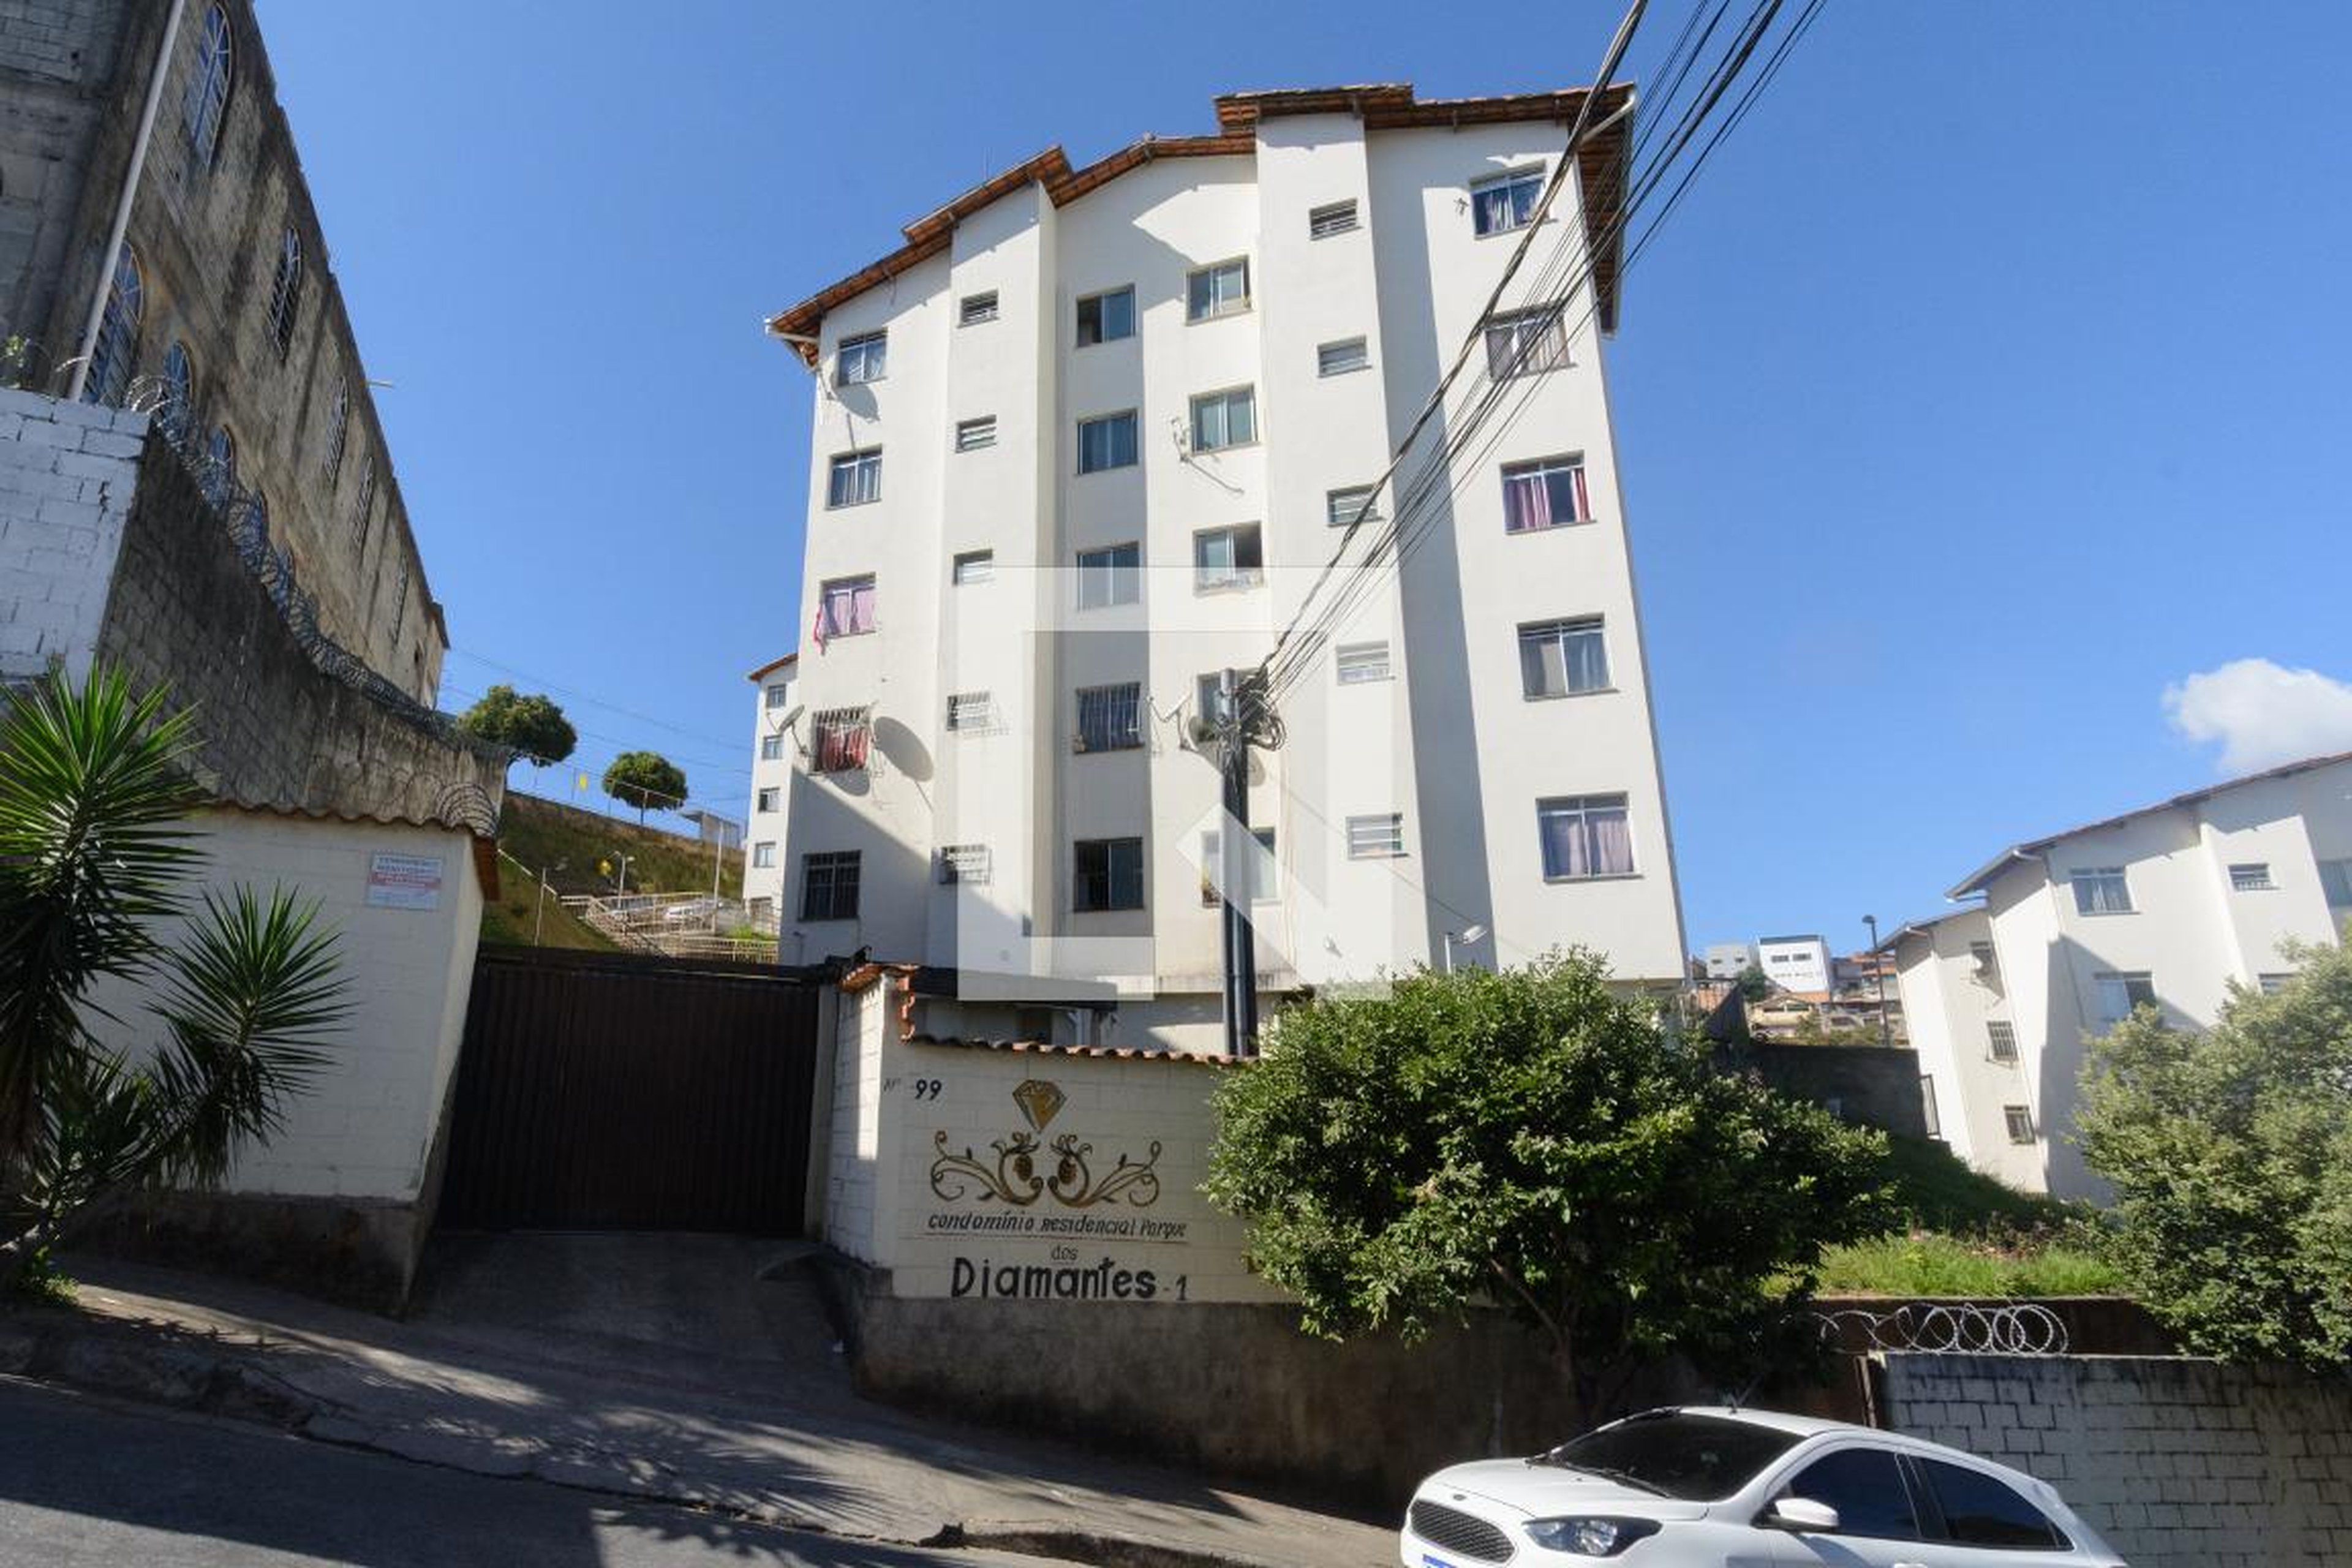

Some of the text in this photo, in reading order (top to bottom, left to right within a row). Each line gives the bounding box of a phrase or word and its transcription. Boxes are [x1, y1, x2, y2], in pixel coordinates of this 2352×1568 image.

[914, 1079, 942, 1101] 99
[1050, 1245, 1079, 1261] dos
[951, 1257, 1156, 1299] Diamantes
